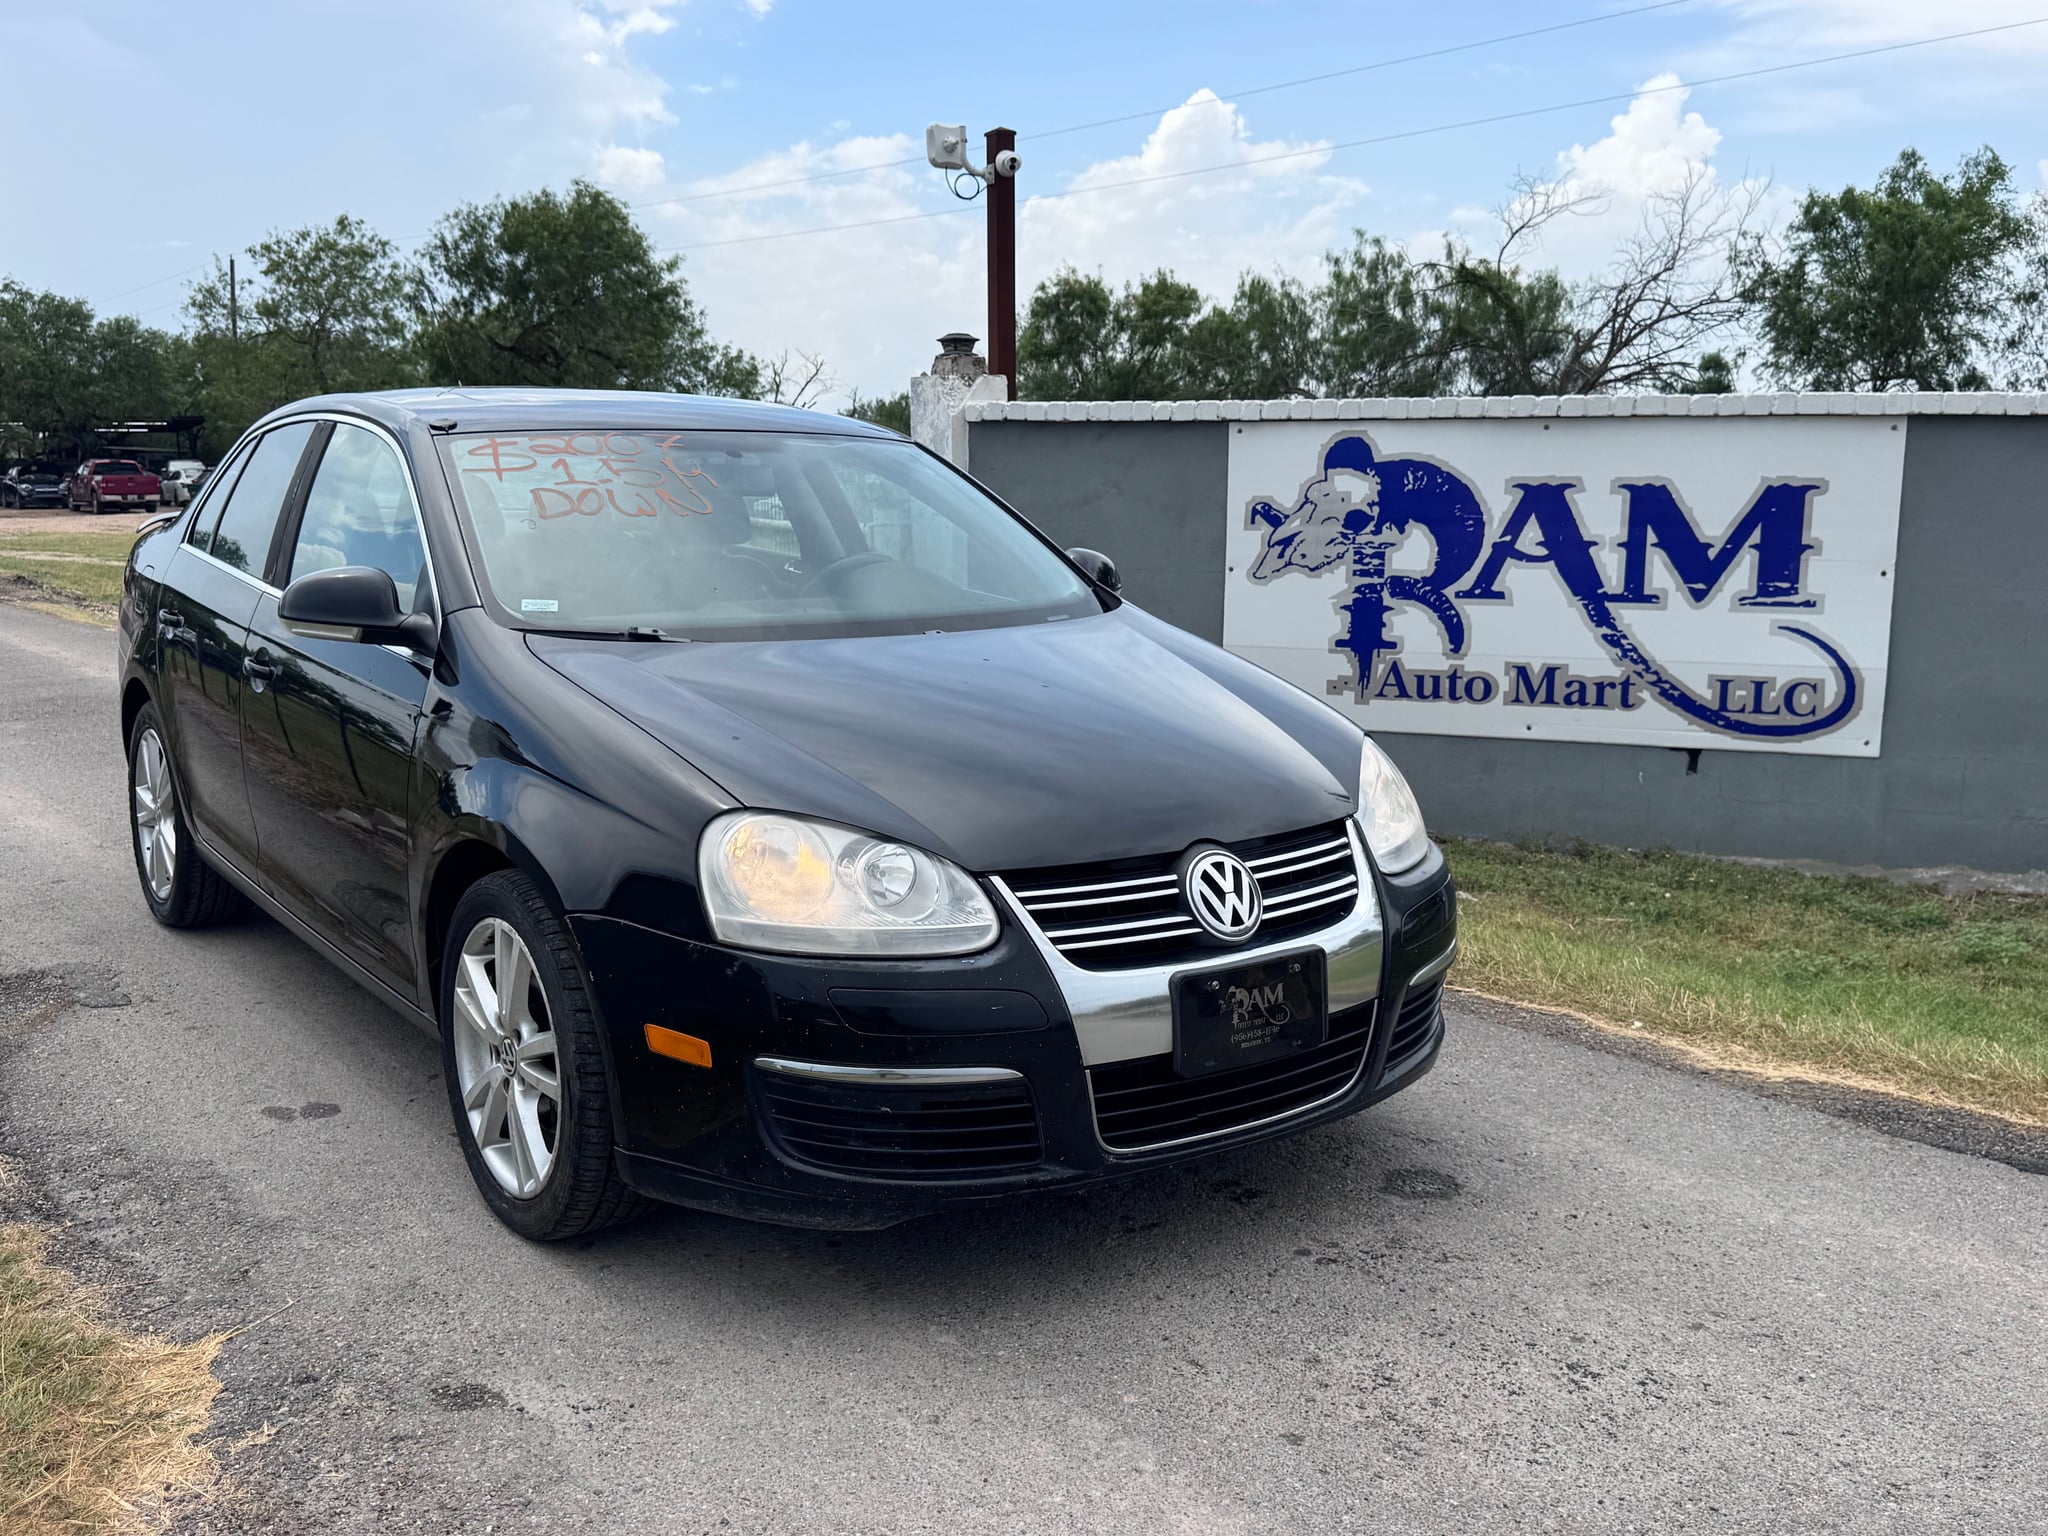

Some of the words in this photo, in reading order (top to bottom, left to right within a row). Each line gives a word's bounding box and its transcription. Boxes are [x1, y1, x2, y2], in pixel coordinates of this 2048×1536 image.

[530, 487, 713, 519] DOWN
[1322, 436, 1828, 655] RAM
[1376, 664, 1493, 702] Auto
[1510, 665, 1637, 710] Mart
[1714, 678, 1820, 718] LLC
[1231, 983, 1284, 1021] RAM
